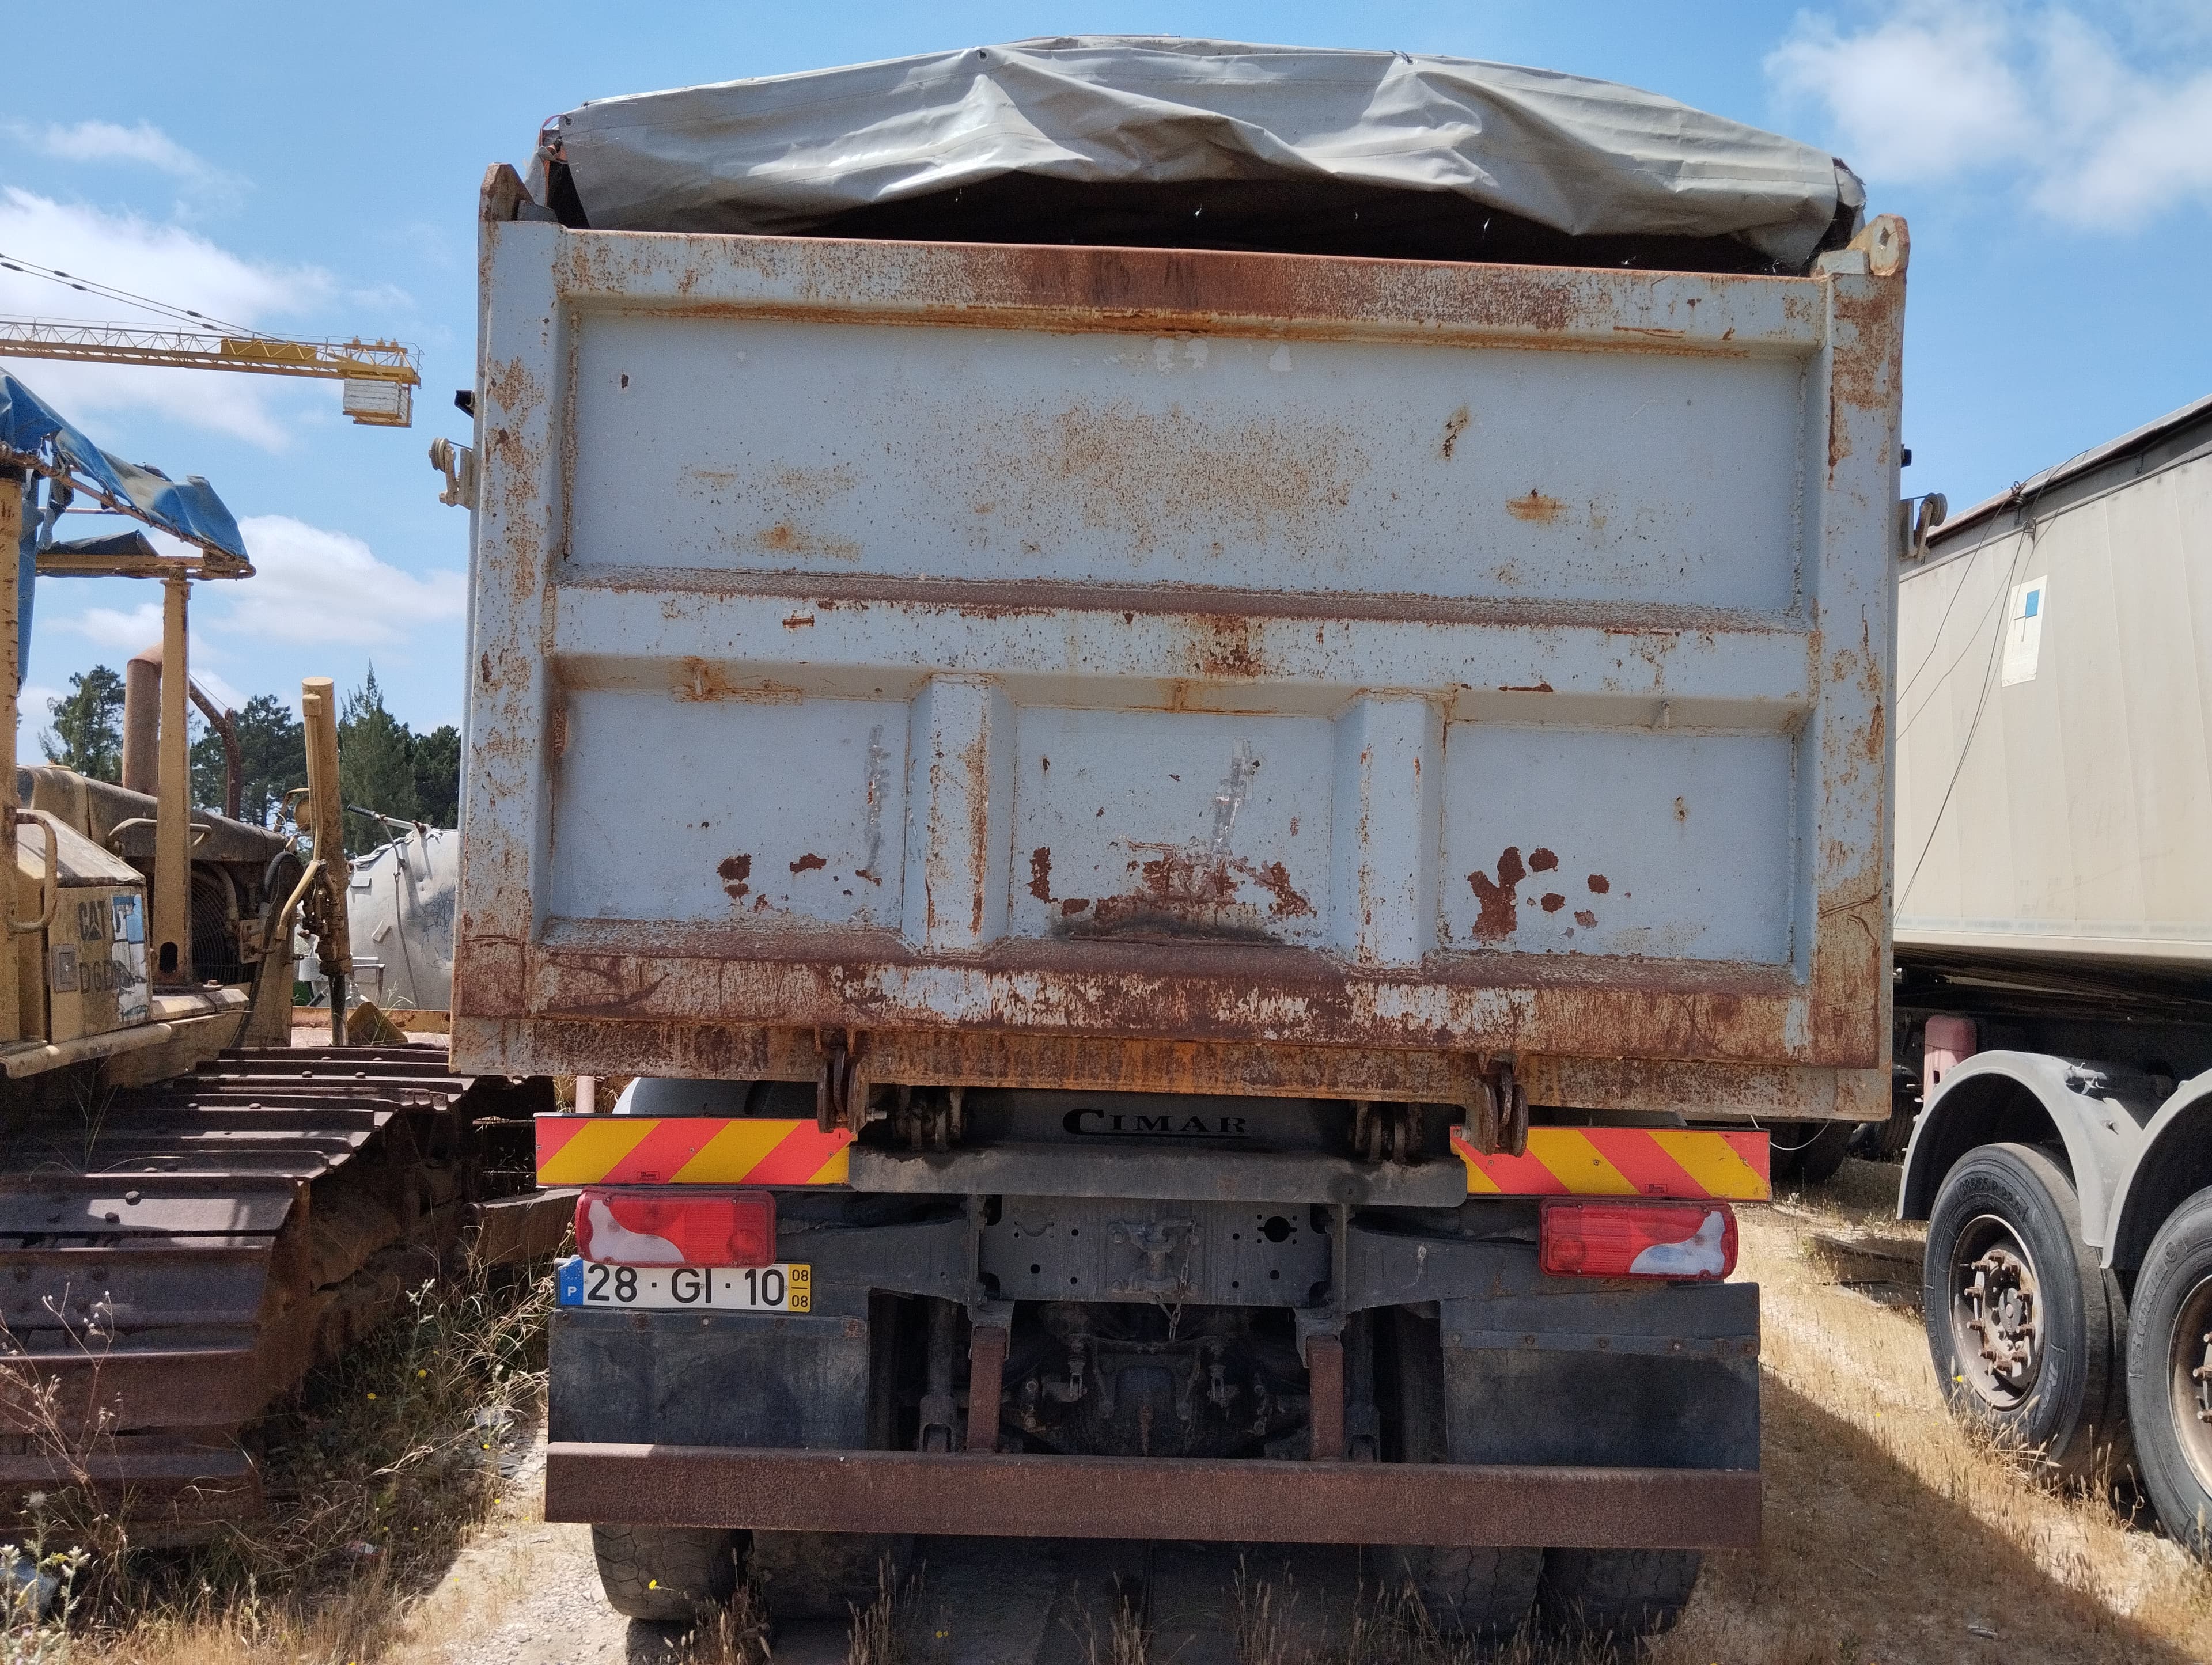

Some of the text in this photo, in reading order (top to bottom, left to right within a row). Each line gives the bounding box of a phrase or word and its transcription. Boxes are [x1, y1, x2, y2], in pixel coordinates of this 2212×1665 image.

[78, 901, 106, 941] CAT
[1062, 1108, 1247, 1136] CIMAR
[792, 1269, 809, 1281] 08
[567, 1286, 577, 1296] P
[791, 1295, 808, 1307] 08
